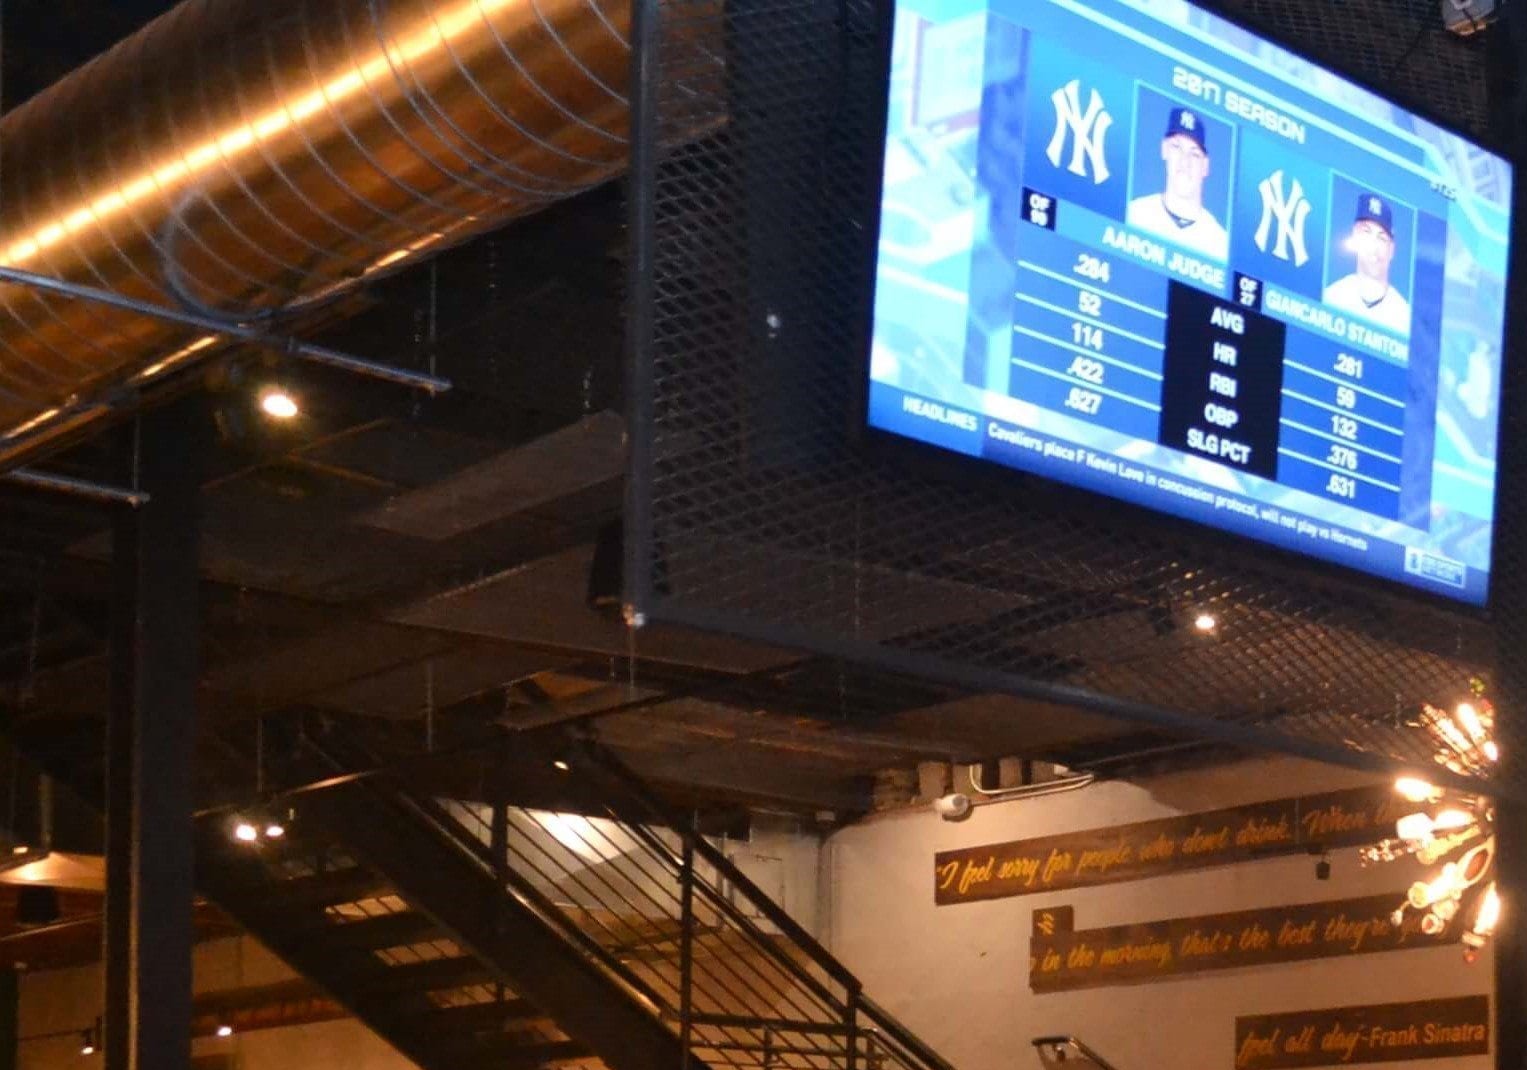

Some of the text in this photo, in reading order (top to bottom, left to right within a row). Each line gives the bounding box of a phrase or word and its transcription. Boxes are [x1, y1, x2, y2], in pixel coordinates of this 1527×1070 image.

[1224, 91, 1306, 144] SEASON
[1102, 226, 1225, 289] AARON JUDGE
[1078, 291, 1102, 317] 52
[1072, 322, 1103, 350] 114
[1210, 307, 1245, 335] AVG
[1265, 290, 1408, 361] GIANCARLO STANTON
[1213, 342, 1237, 366] HR
[1209, 373, 1237, 398] RBI
[902, 395, 977, 432] HEADLINES
[1204, 403, 1238, 428] OBP
[1331, 415, 1357, 440] 132
[1187, 428, 1251, 464] SLG PCT
[987, 422, 1043, 452] Cavaliers
[1043, 442, 1076, 463] place
[1085, 452, 1118, 475] Kevin
[1119, 462, 1144, 483] Love
[1157, 477, 1215, 505] concussion
[959, 857, 995, 894] feel
[998, 858, 1039, 886] sorry
[1043, 848, 1072, 883] for
[1076, 838, 1132, 874] people
[1067, 944, 1095, 969] the
[1239, 923, 1271, 950] the
[1278, 919, 1317, 945] best
[1284, 1025, 1316, 1053] all
[1423, 1022, 1486, 1045] Sinatra
